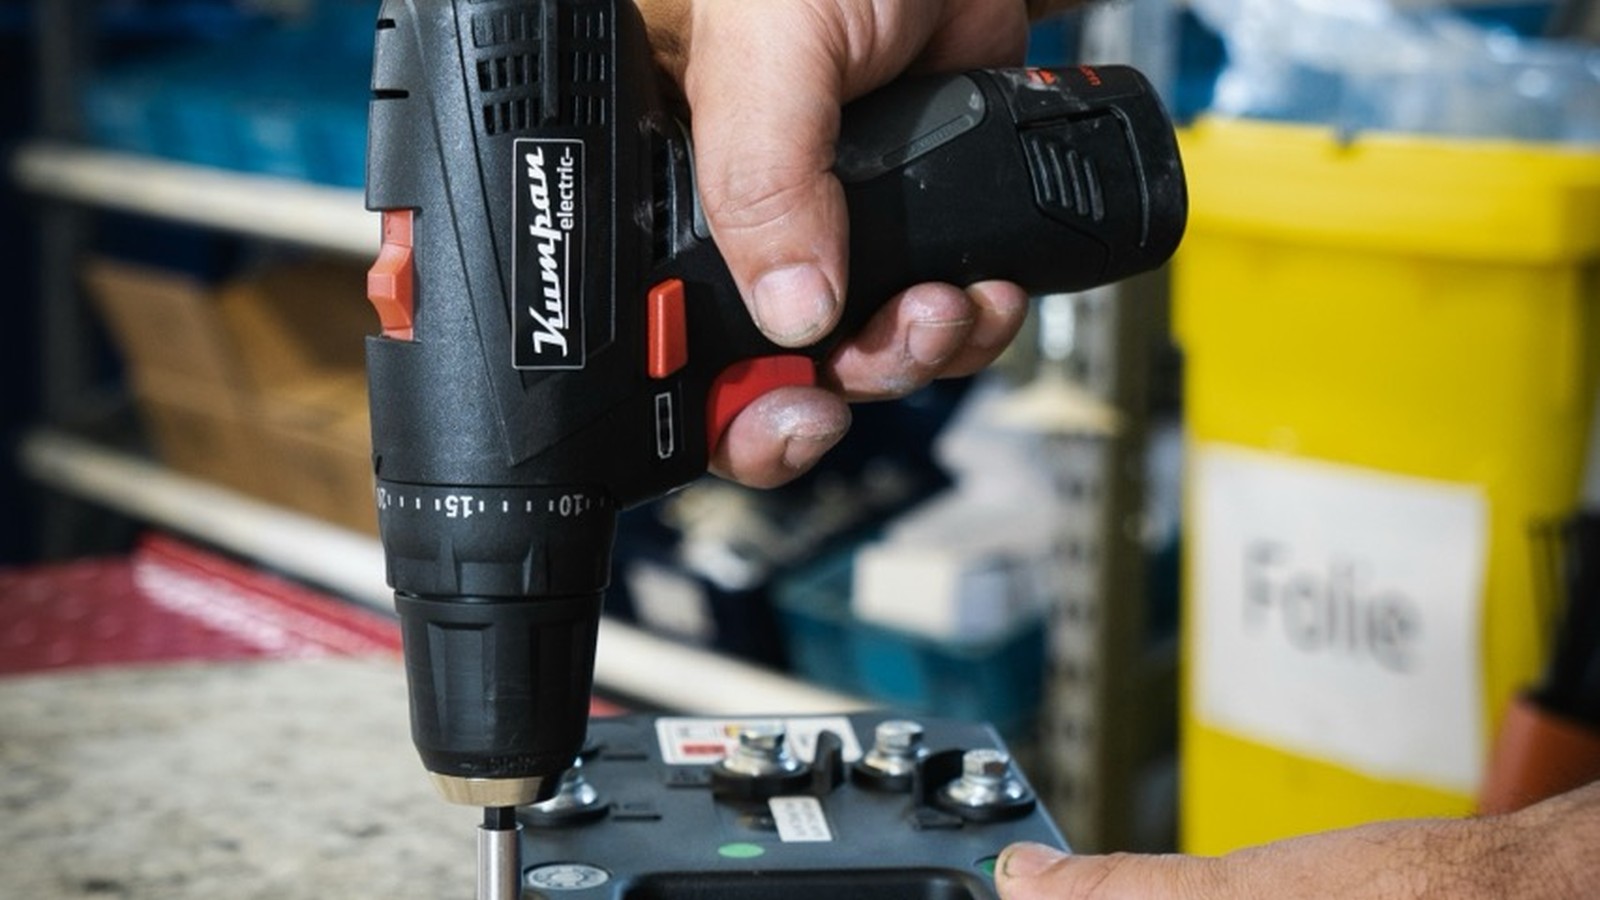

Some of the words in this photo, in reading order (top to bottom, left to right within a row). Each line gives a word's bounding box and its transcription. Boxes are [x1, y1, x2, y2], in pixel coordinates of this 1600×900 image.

[526, 147, 569, 357] Kumpan
[444, 494, 474, 519] 15
[559, 494, 584, 517] 10
[1242, 538, 1424, 676] Folie
